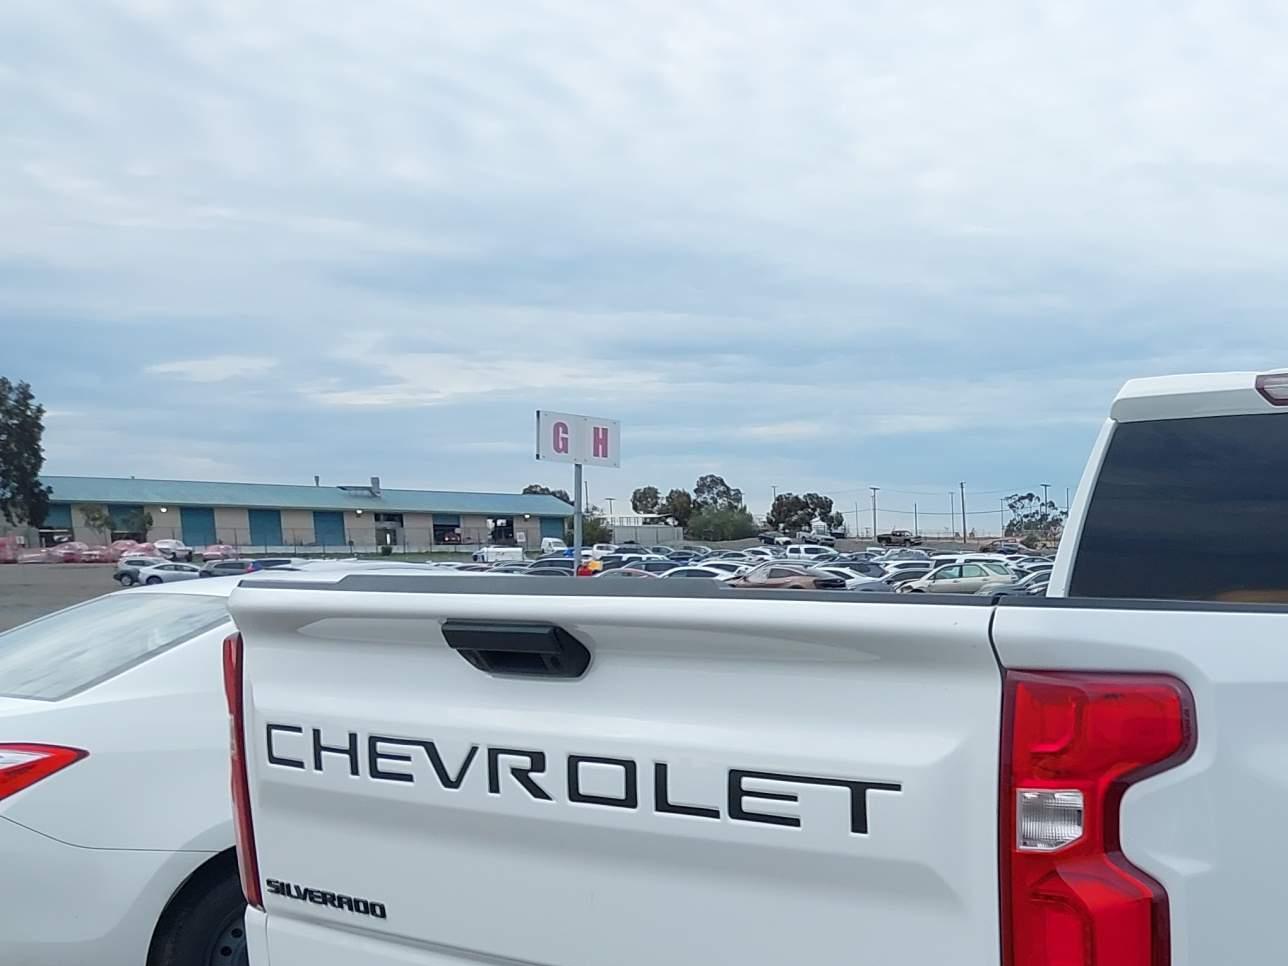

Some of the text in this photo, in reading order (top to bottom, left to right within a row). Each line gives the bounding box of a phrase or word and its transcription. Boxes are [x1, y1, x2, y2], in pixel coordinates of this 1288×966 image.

[553, 421, 609, 458] G H
[266, 724, 902, 835] CHEVROLET
[265, 878, 387, 920] SILVERADO
